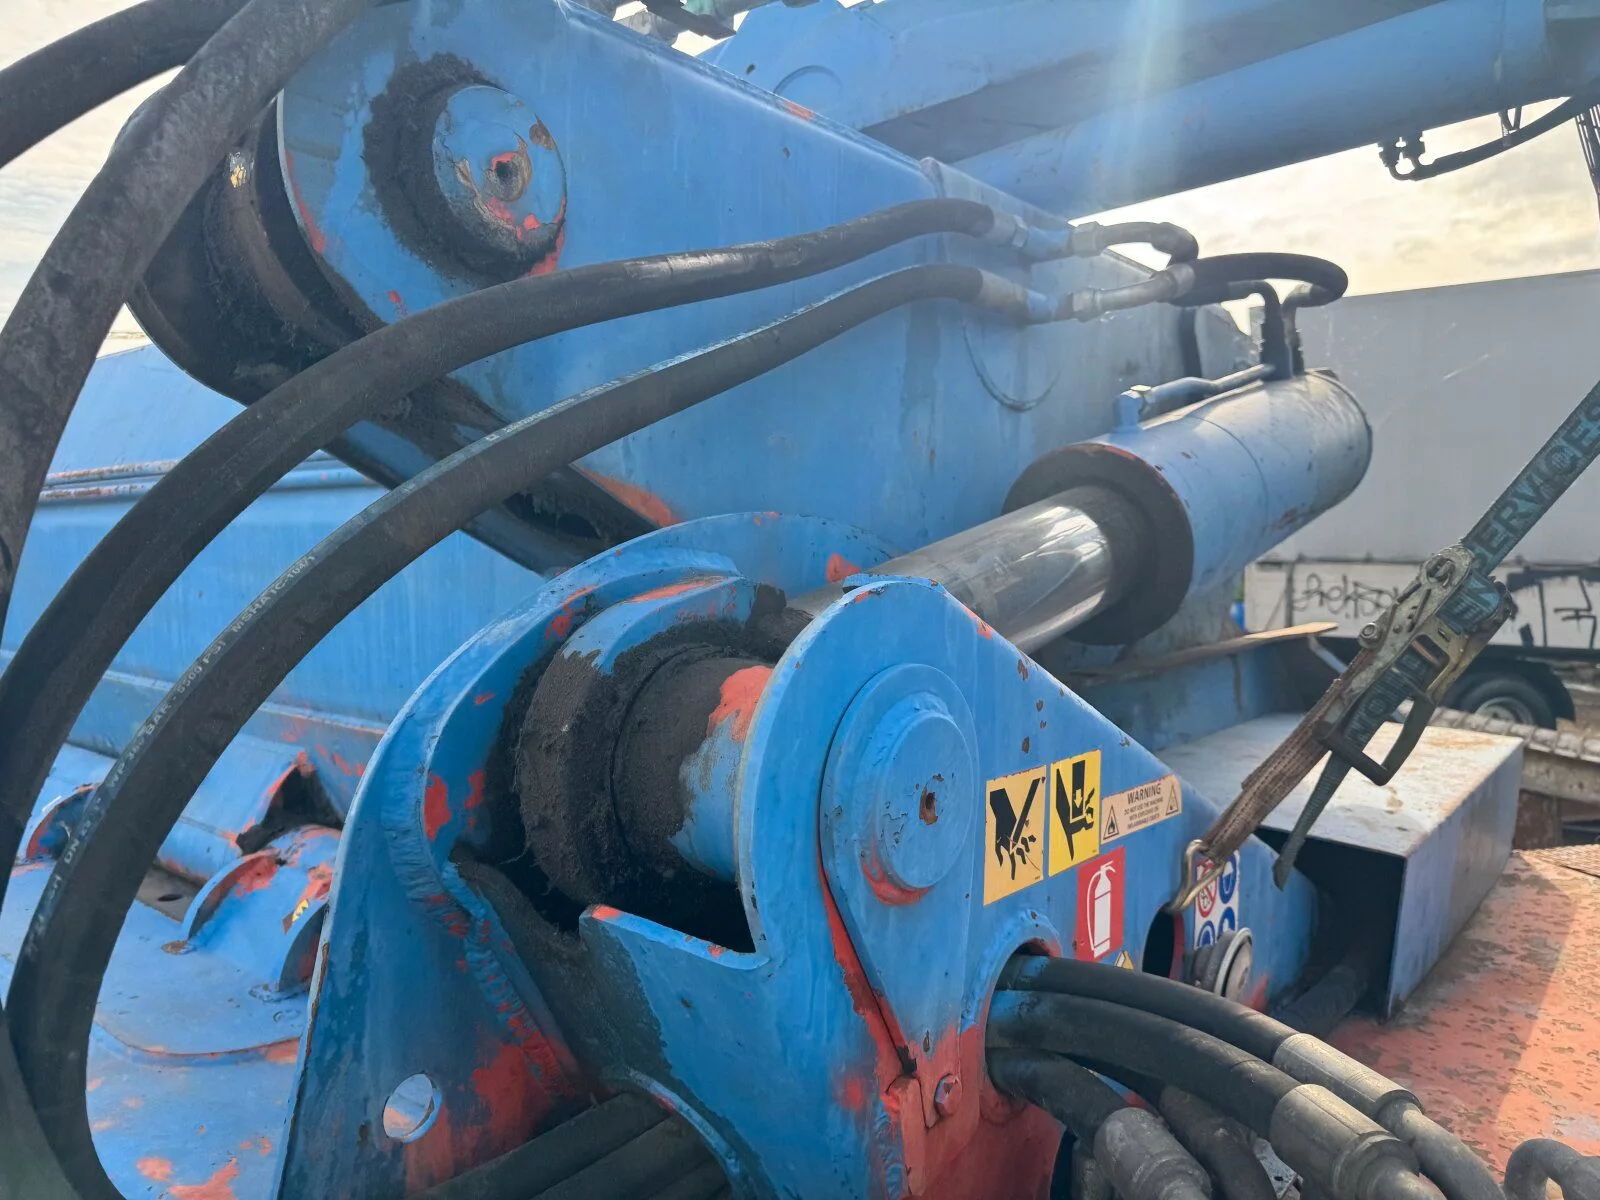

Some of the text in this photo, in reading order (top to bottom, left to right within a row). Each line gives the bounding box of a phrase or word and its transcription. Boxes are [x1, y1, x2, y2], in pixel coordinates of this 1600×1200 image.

[145, 701, 172, 735] BAR
[202, 640, 226, 664] PSI
[231, 595, 271, 633] MSHA
[1127, 783, 1161, 805] WARNING
